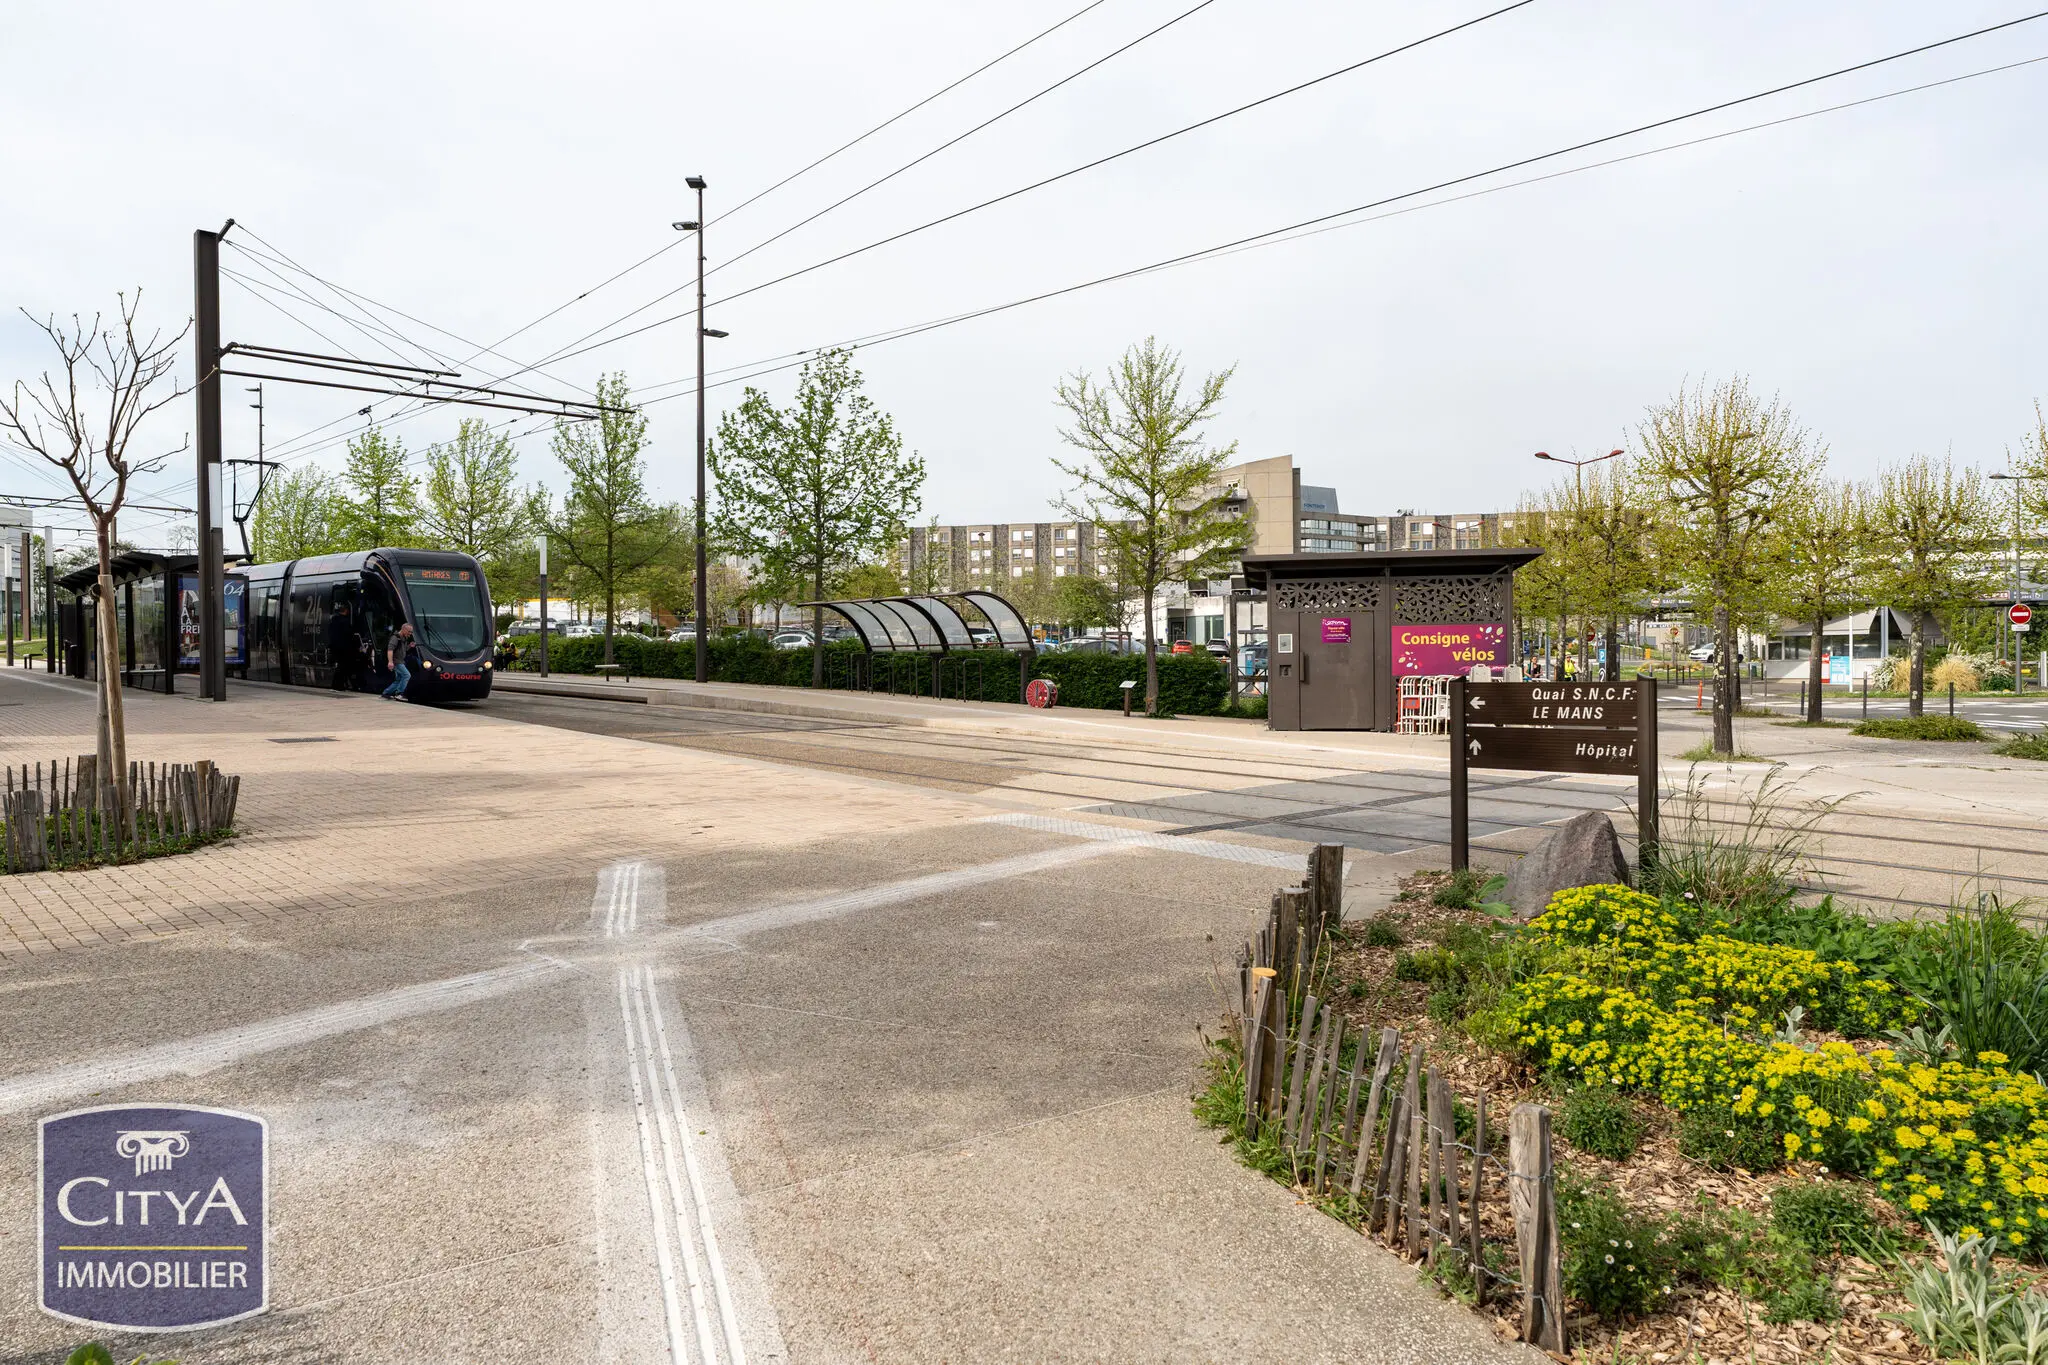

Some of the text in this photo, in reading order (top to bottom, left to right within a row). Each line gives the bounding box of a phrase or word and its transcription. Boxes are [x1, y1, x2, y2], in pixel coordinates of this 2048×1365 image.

[1401, 632, 1470, 648] Consigne
[1452, 647, 1495, 661] vélos
[1532, 688, 1634, 700] Quai S.N.C.F.
[1532, 707, 1604, 720] LE MANS
[1575, 743, 1634, 759] Hôpital
